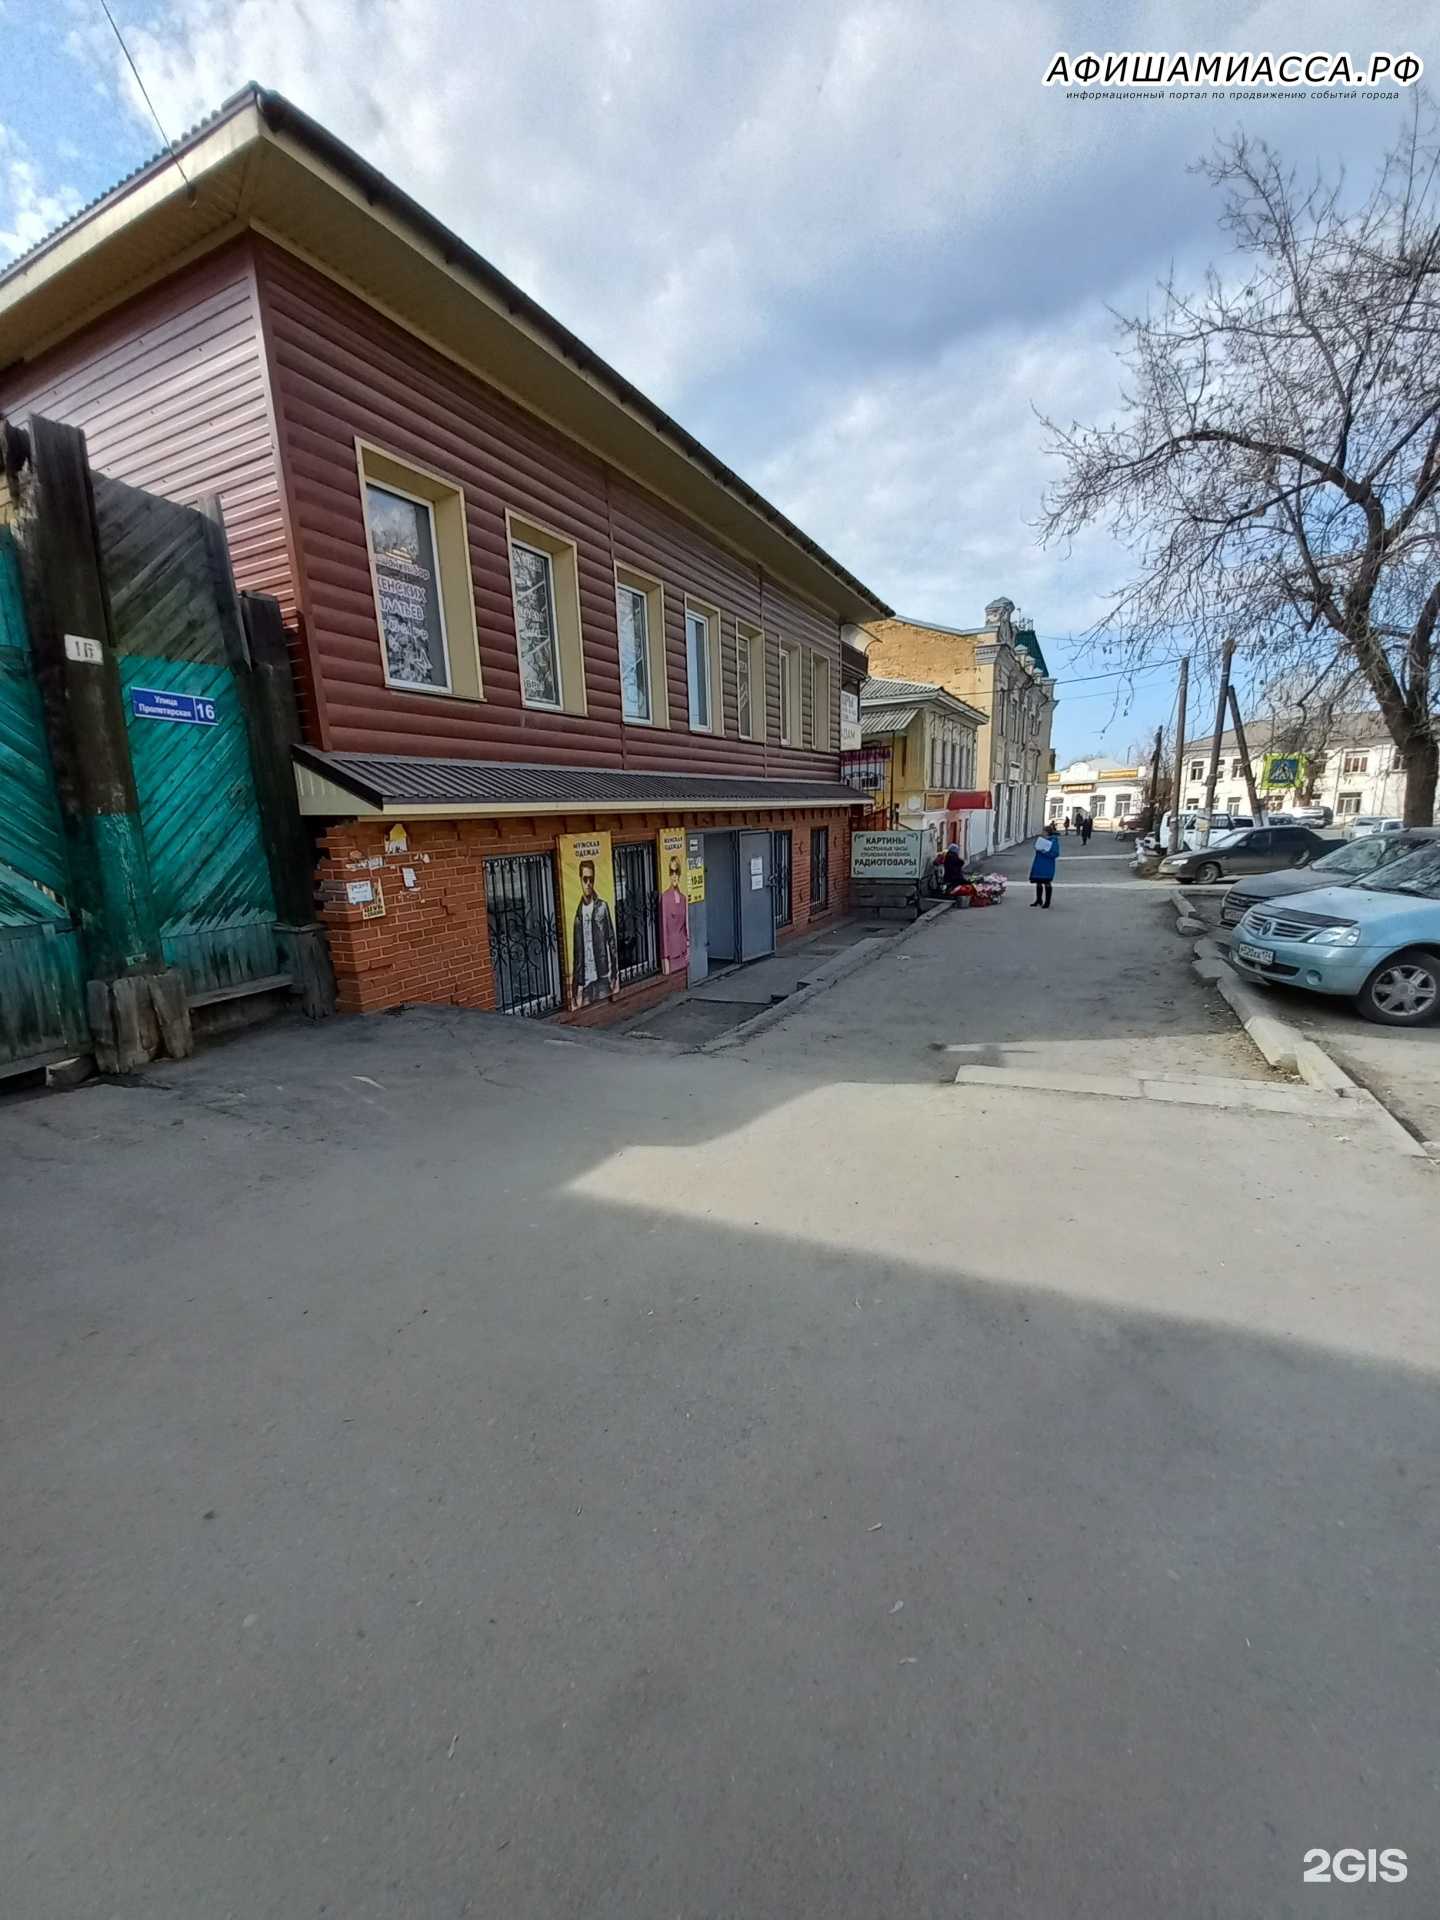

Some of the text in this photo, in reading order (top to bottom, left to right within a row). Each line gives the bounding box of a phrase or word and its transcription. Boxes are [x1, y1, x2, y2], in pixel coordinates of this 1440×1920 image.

[377, 575, 427, 603] ЕНСКИХ
[153, 695, 178, 706] Улица
[138, 703, 193, 717] Пролетарская
[197, 703, 215, 719] 16
[865, 837, 906, 845] КАРТИНЫ
[854, 858, 917, 867] РАДИОТОВАРЫ
